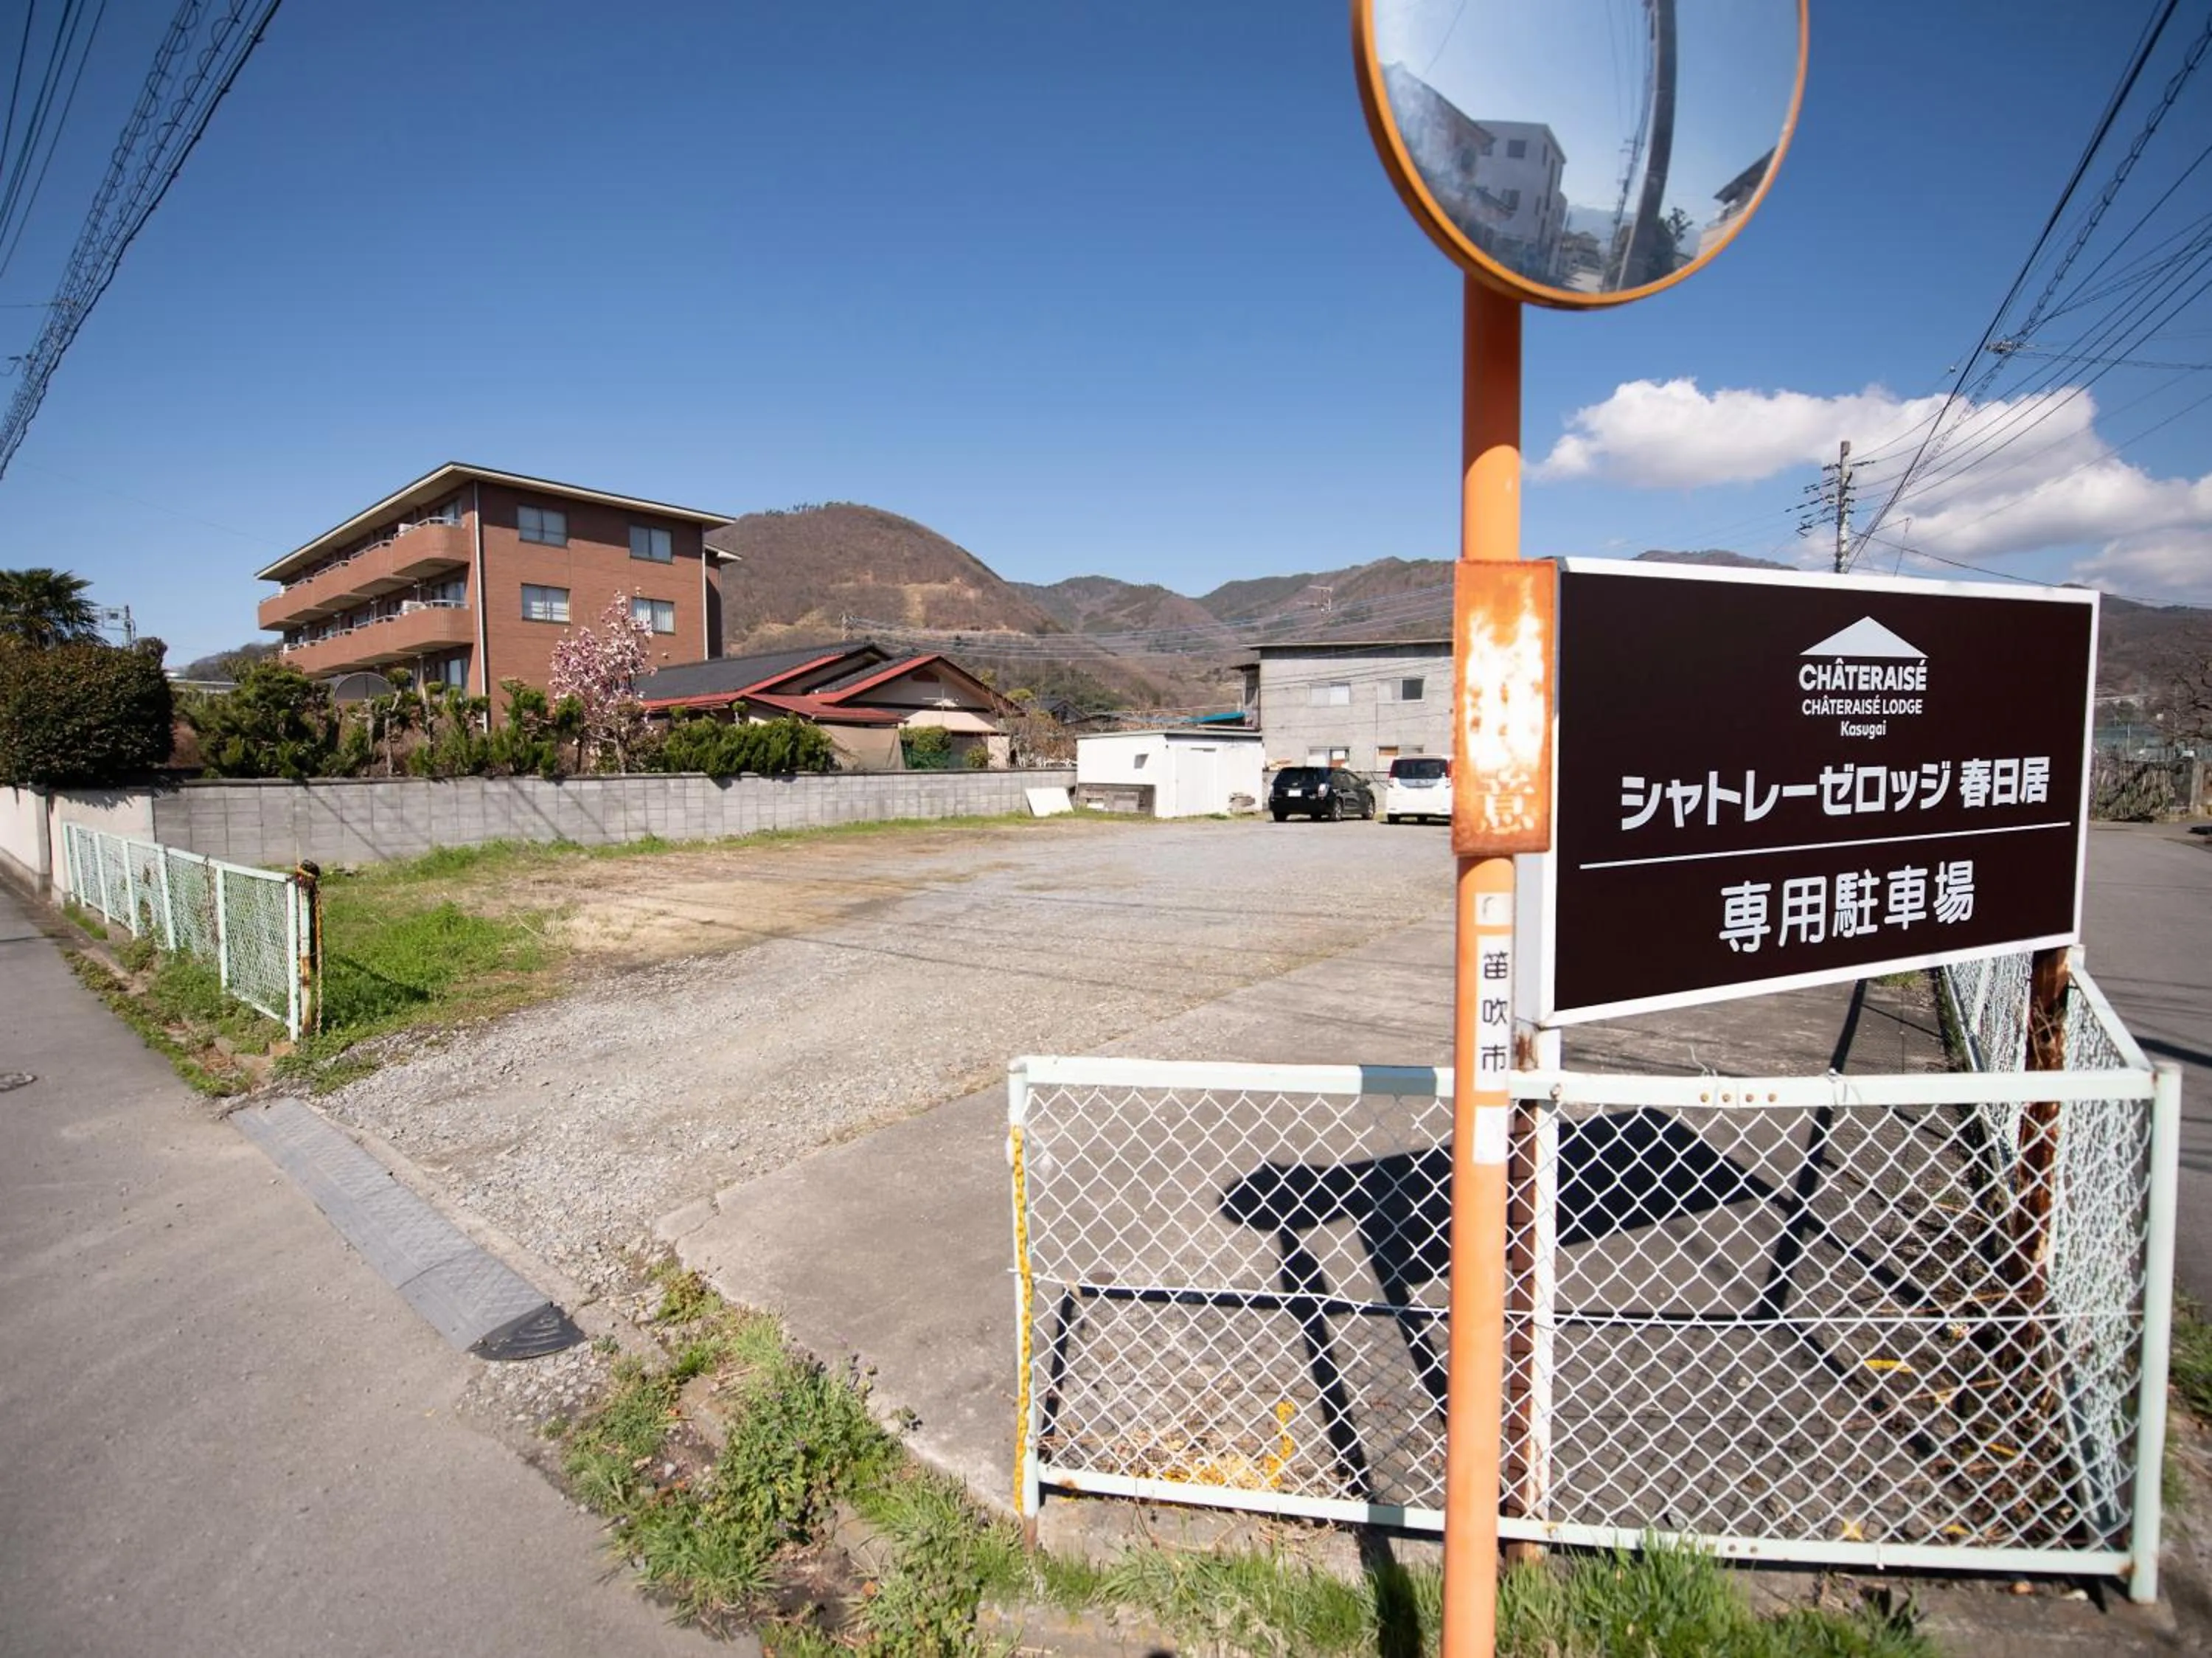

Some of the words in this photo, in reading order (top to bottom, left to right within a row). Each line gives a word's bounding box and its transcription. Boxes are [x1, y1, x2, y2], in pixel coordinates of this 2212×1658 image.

[1798, 657, 1927, 691] CHÂTERAISÉ
[1801, 694, 1879, 715] CHÂTERAISÉ
[1882, 698, 1923, 715] LODGE
[1840, 719, 1887, 740] Kasugai
[1719, 860, 1975, 953] 専用駐車場
[1481, 950, 1509, 1072] 笛吹市
